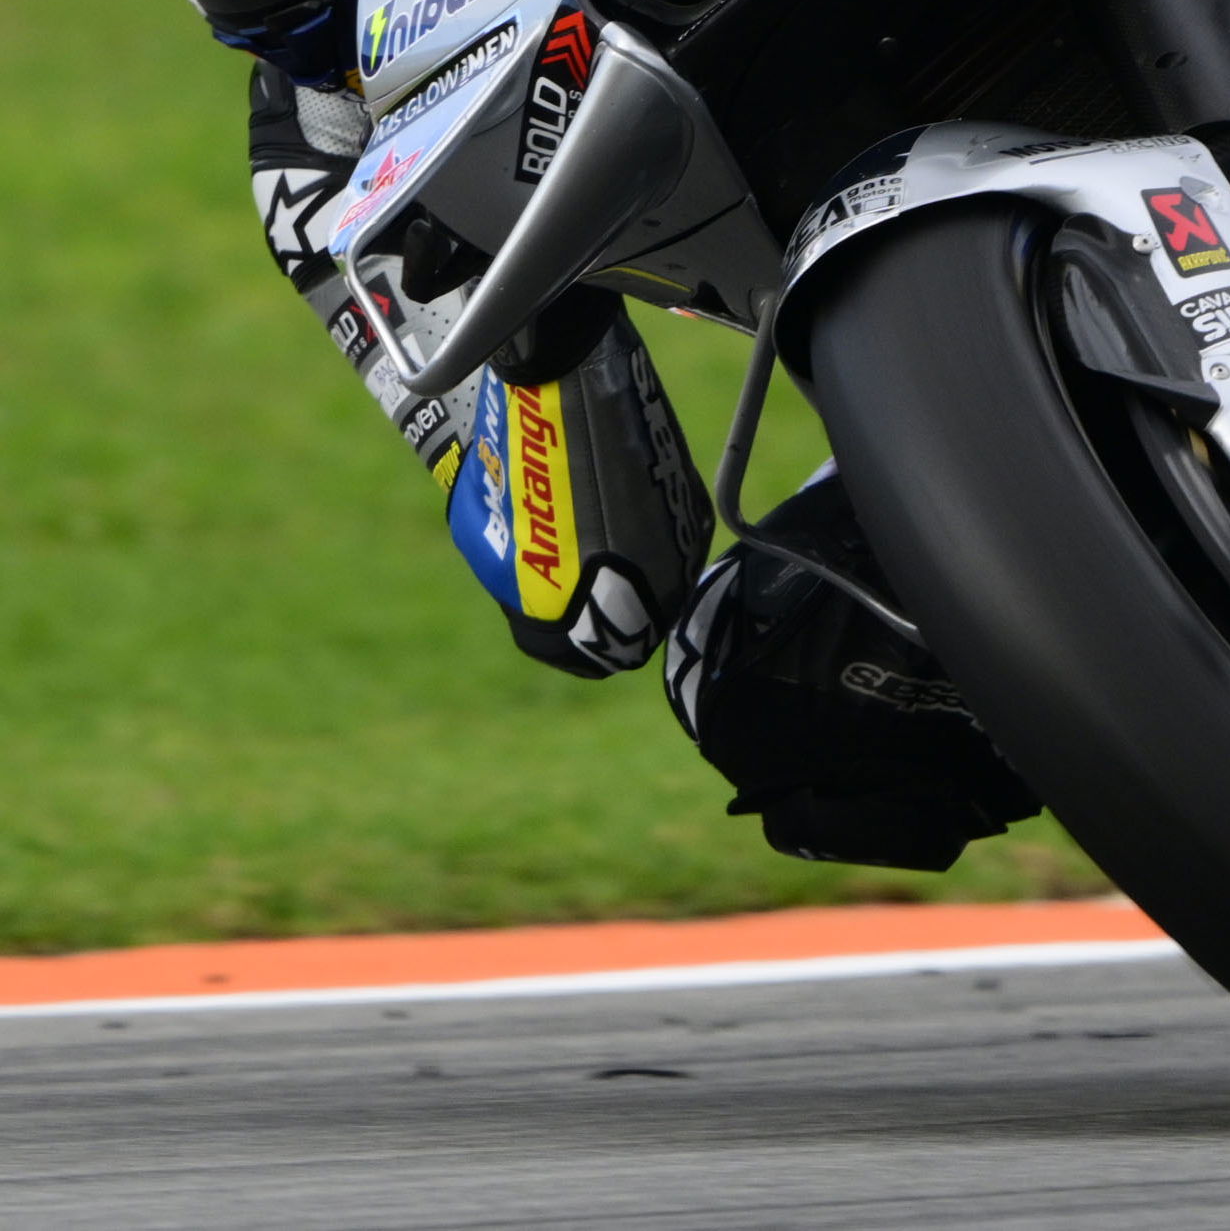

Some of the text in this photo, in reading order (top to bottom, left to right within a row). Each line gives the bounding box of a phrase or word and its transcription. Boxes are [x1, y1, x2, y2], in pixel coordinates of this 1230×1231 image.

[405, 67, 460, 122] GLOW
[466, 25, 517, 75] MEN
[523, 75, 568, 175] BOLD
